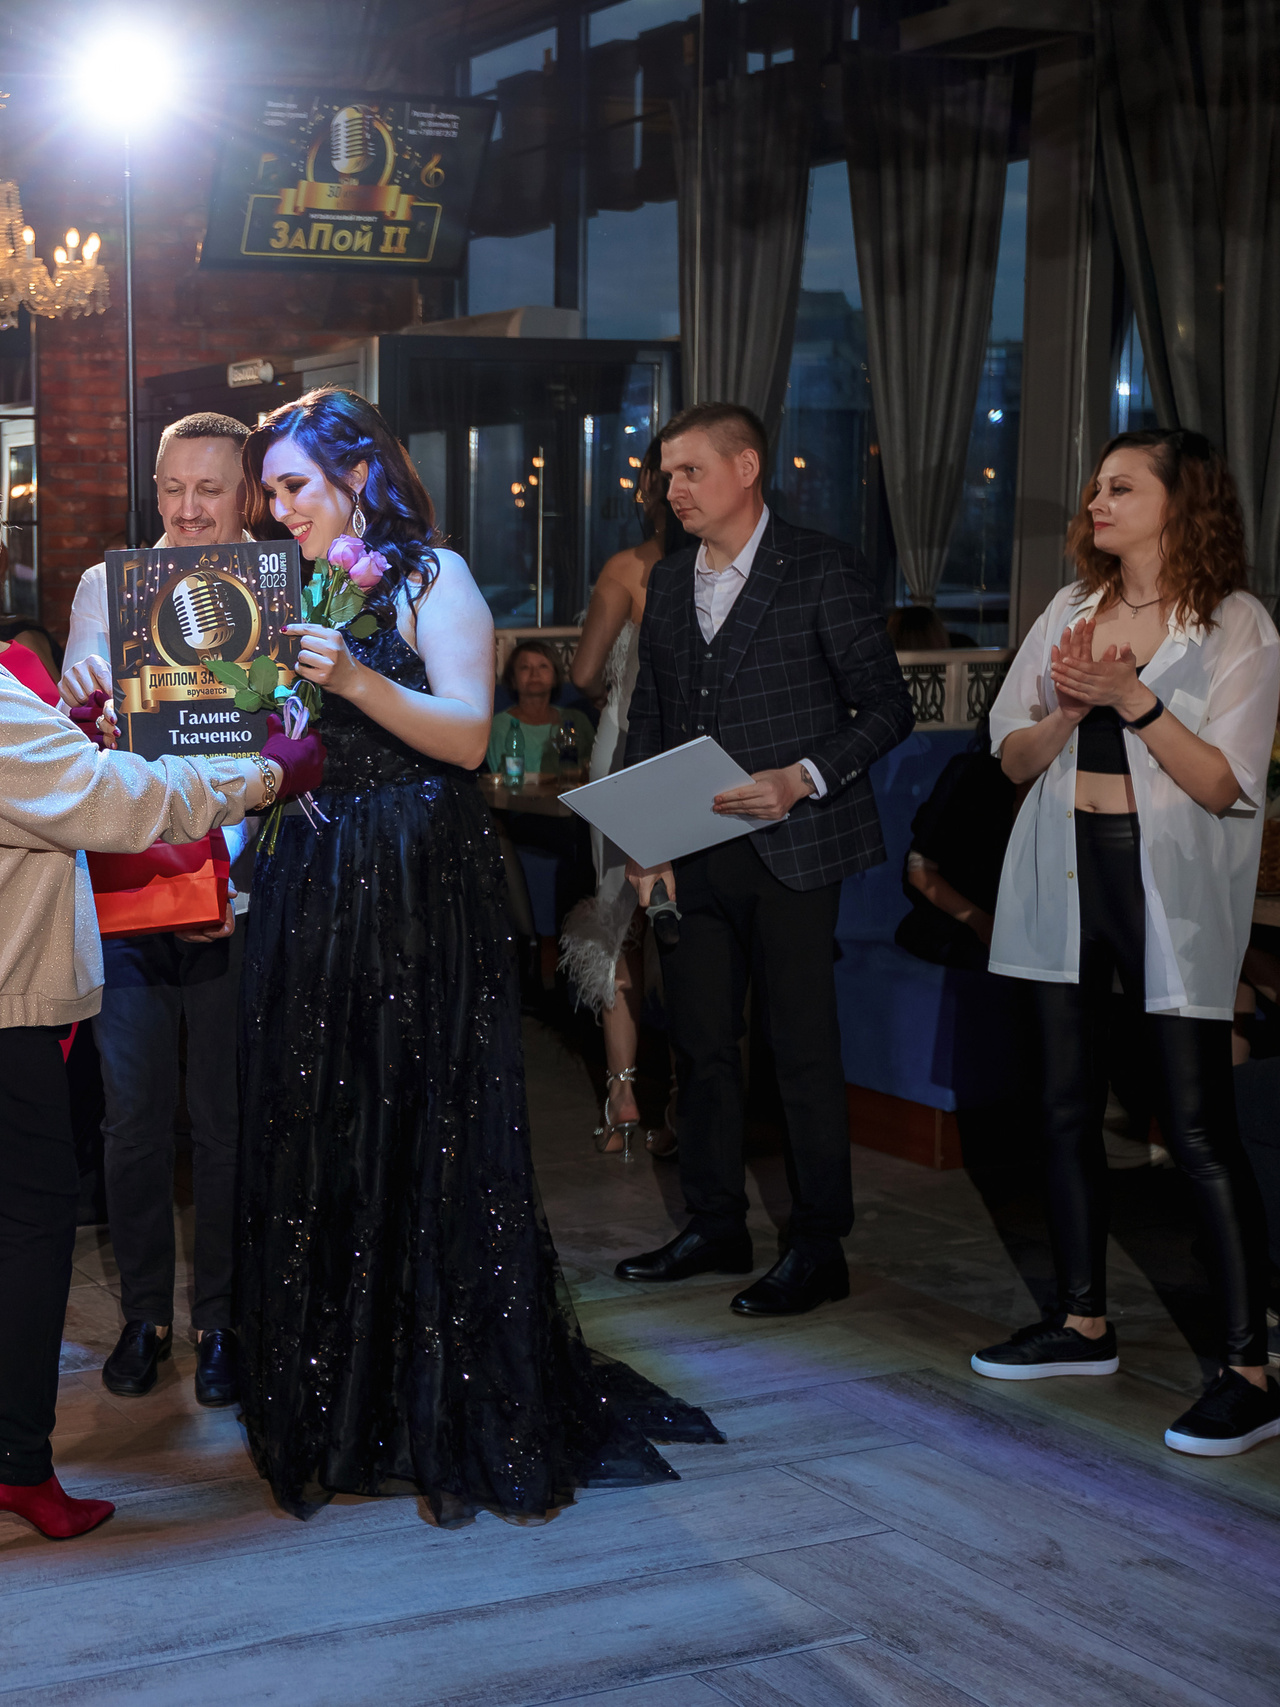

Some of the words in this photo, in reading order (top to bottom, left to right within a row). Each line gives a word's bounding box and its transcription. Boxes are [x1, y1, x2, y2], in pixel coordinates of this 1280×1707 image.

[258, 553, 279, 574] 30
[259, 573, 287, 589] 2023
[149, 671, 198, 689] ДИПЛОМ
[200, 669, 215, 685] ЗА
[186, 687, 227, 698] вручается
[179, 710, 240, 726] Галине
[168, 729, 253, 746] Ткаченко
